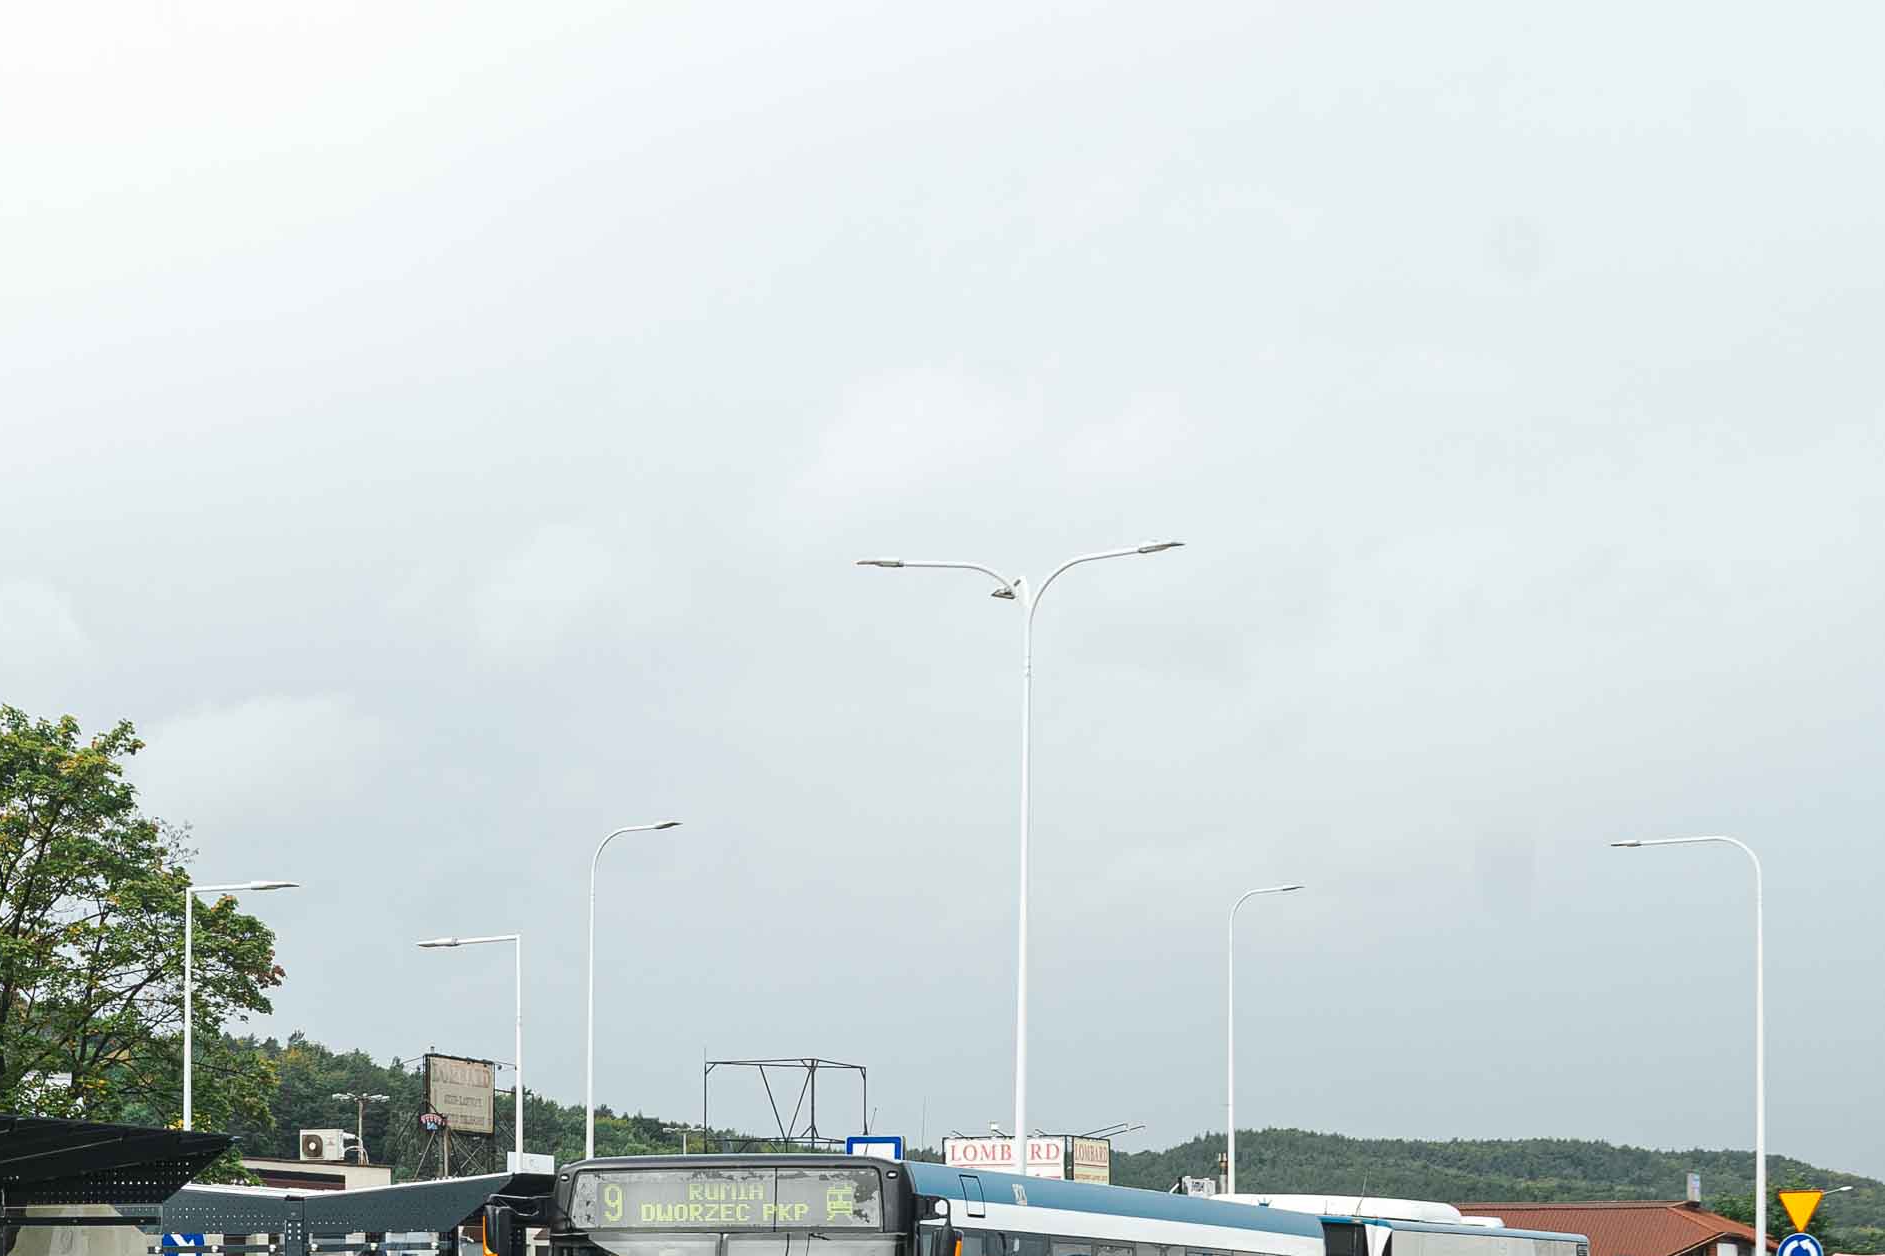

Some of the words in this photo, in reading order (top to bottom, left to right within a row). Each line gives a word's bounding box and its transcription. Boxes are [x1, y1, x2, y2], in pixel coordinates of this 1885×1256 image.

[950, 1140, 1060, 1161] LOMBRD
[1074, 1143, 1108, 1162] LOMBARD
[688, 1183, 764, 1201] RUMIA
[603, 1183, 624, 1221] 9
[640, 1203, 751, 1222] DWORZEC
[763, 1203, 811, 1222] PKP
